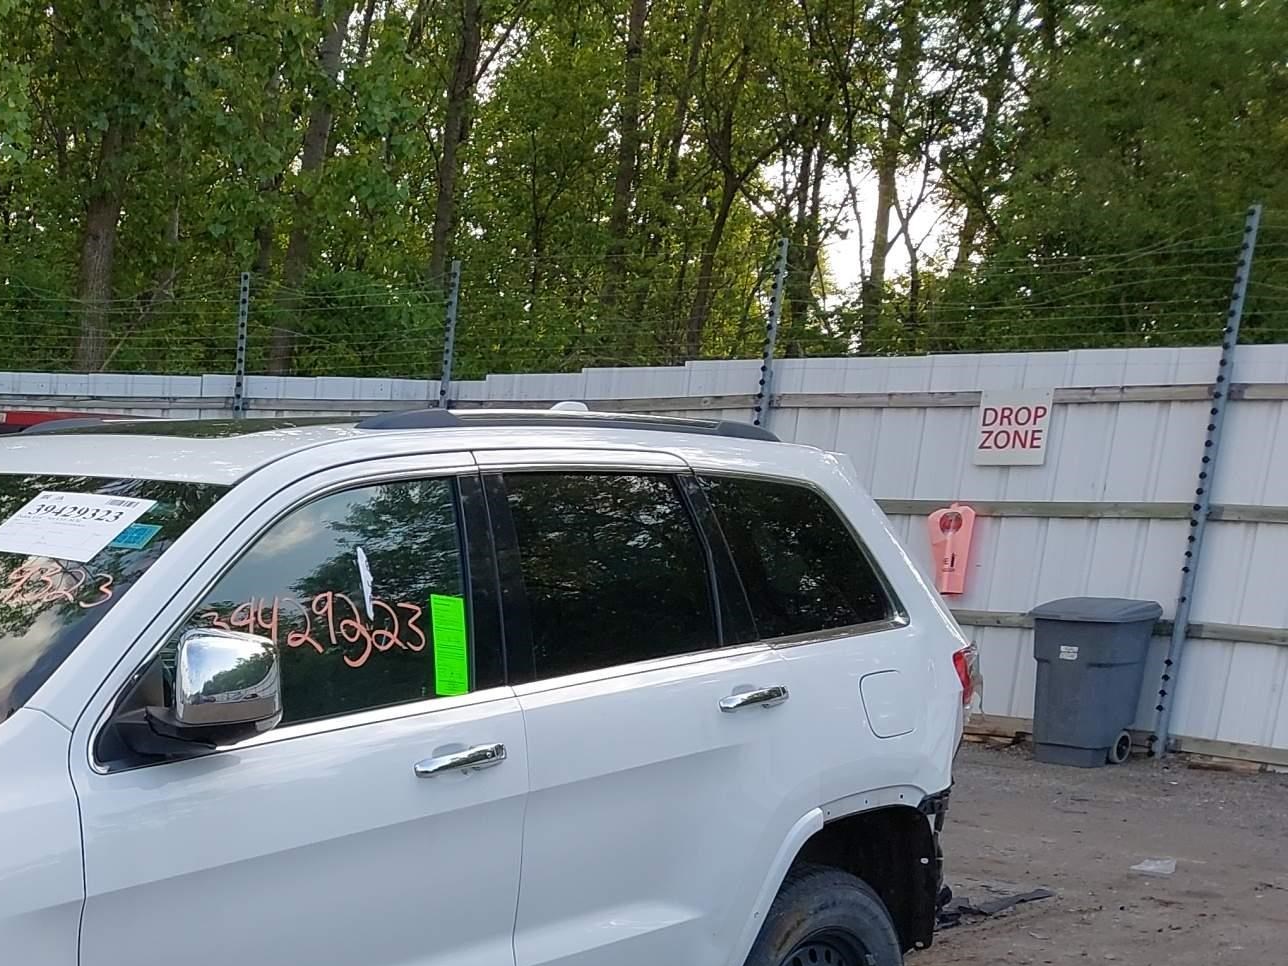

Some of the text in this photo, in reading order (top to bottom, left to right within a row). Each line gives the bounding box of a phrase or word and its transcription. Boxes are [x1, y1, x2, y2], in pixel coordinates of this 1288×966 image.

[982, 406, 1048, 427] DROP
[978, 429, 1043, 449] ZONE
[27, 503, 124, 523] 39429323
